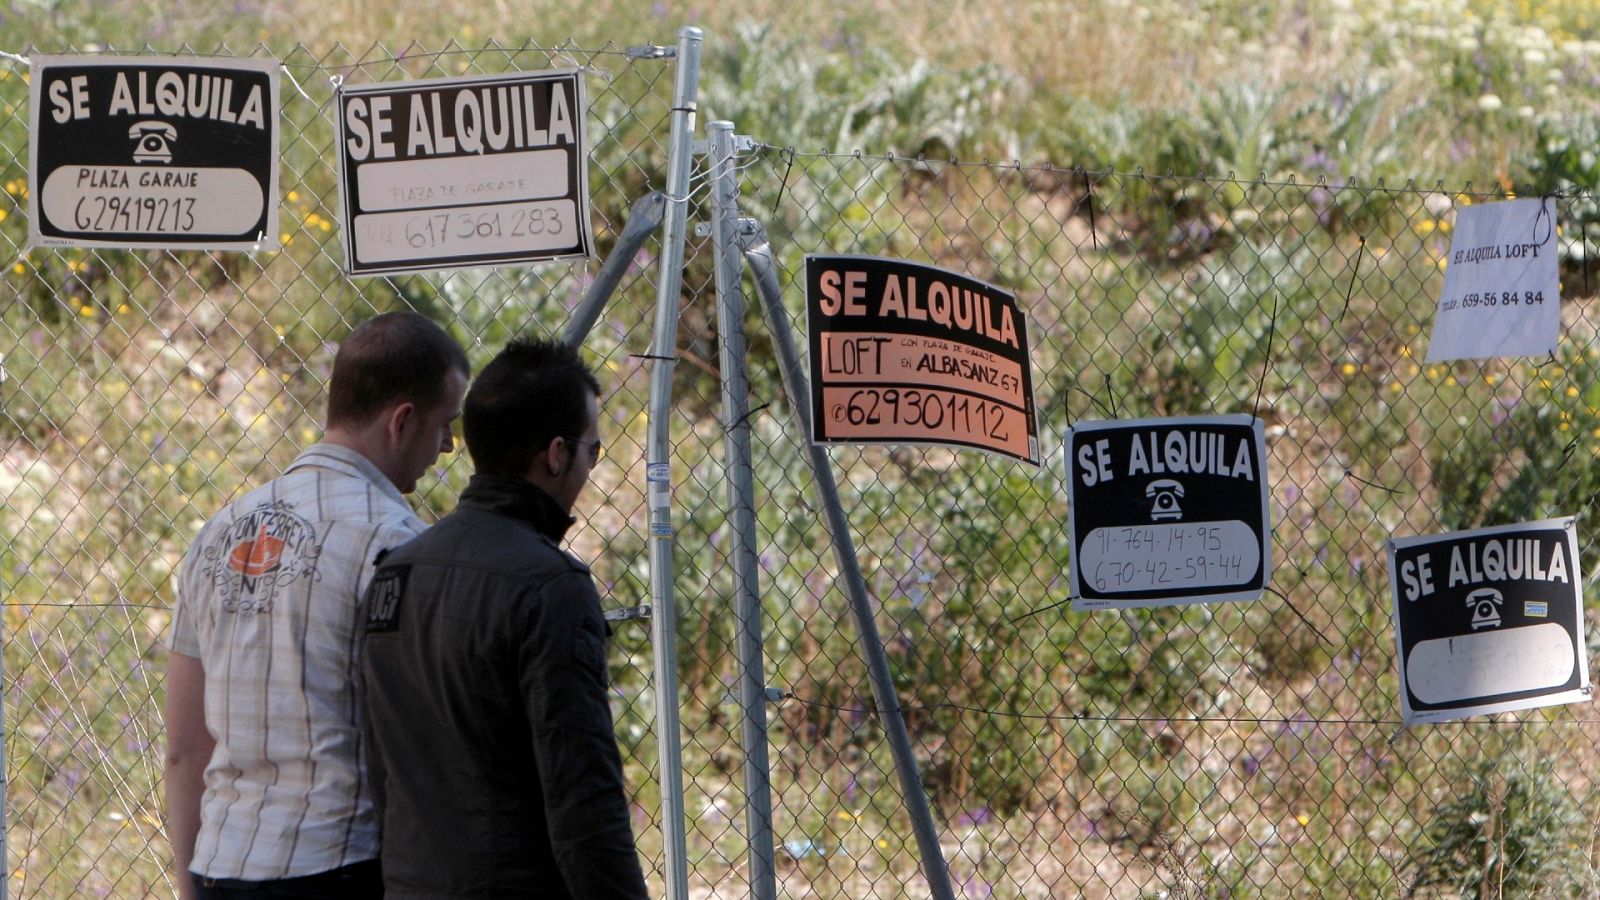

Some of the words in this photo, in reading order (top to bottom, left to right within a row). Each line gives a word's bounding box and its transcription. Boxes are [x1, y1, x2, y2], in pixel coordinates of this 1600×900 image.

[49, 75, 90, 124] SE
[109, 71, 265, 130] ALQUILA
[346, 97, 396, 161] SE
[407, 82, 575, 156] ALQUILA
[77, 168, 129, 188] PLAZA
[139, 172, 198, 187] GARAJE
[74, 195, 197, 232] 629419213
[404, 213, 450, 248] 617
[457, 213, 502, 239] 361
[510, 207, 563, 238] 283
[1454, 250, 1464, 264] SE
[1464, 245, 1501, 264] ALQUILA
[1505, 244, 1540, 258] LOFT
[819, 270, 867, 317] SE
[878, 273, 1019, 350] ALQUILA
[1462, 292, 1497, 309] 659-56
[1502, 291, 1519, 305] 84
[1525, 291, 1544, 305] 84
[826, 336, 893, 375] LOFT
[901, 338, 918, 347] CON
[953, 344, 962, 352] DE
[901, 357, 912, 368] EN
[916, 353, 999, 387] ALBASANZ
[1001, 374, 1019, 394] 67
[847, 389, 1008, 442] 629301112
[1078, 438, 1114, 487] SE
[1128, 430, 1254, 481] ALQUILA
[1401, 553, 1435, 601] SE
[1449, 539, 1569, 588] ALQUILA
